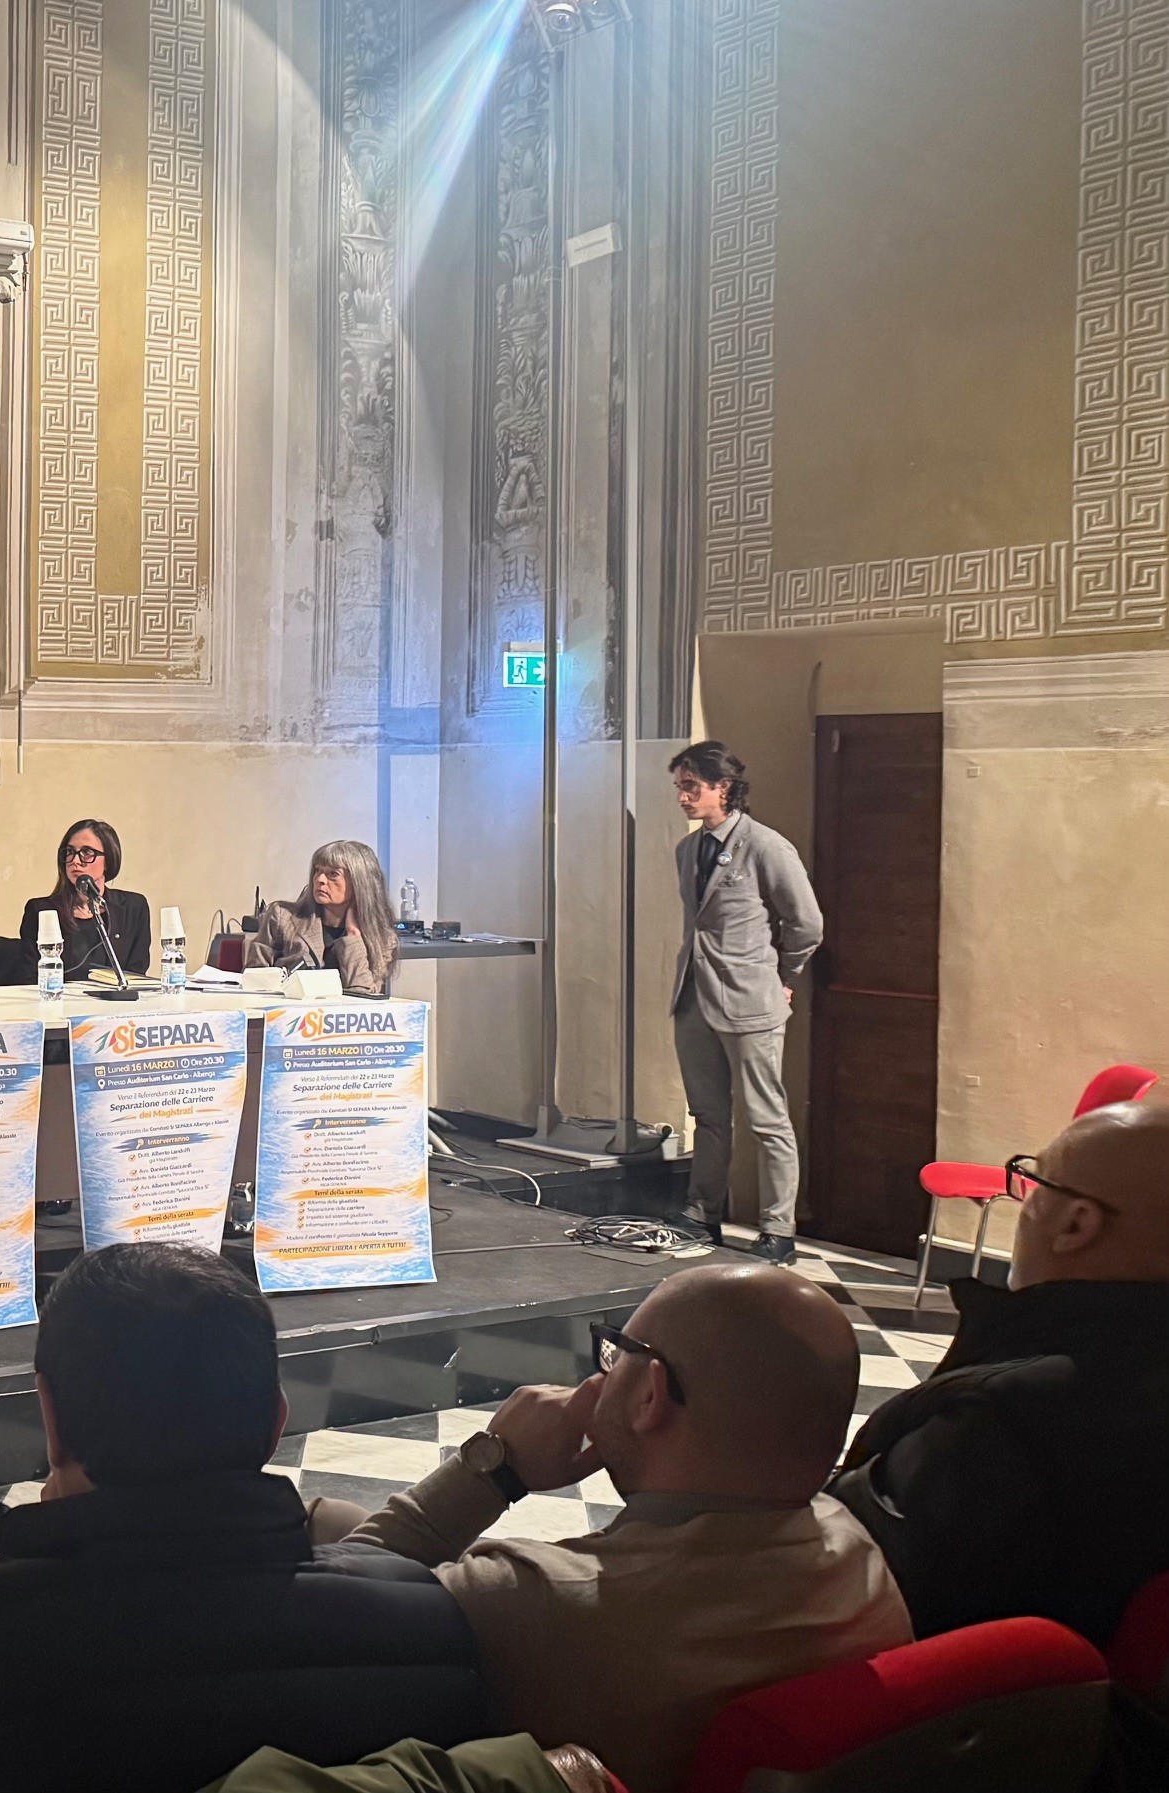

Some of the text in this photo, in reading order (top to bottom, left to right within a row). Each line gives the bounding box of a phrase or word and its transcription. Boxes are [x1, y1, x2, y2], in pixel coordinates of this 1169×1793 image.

[318, 1047, 327, 1055] 16
[329, 1046, 359, 1055] MARZO
[144, 1060, 176, 1070] MARZO
[204, 1056, 224, 1065] 20.30
[311, 1059, 343, 1067] Auditorium
[127, 1075, 160, 1084] Auditorium
[174, 1072, 189, 1080] Carlo
[193, 1071, 215, 1079] Albenga
[293, 1081, 392, 1093] Separazione delle Carriere
[110, 1095, 213, 1112] Separazione delle Carriere
